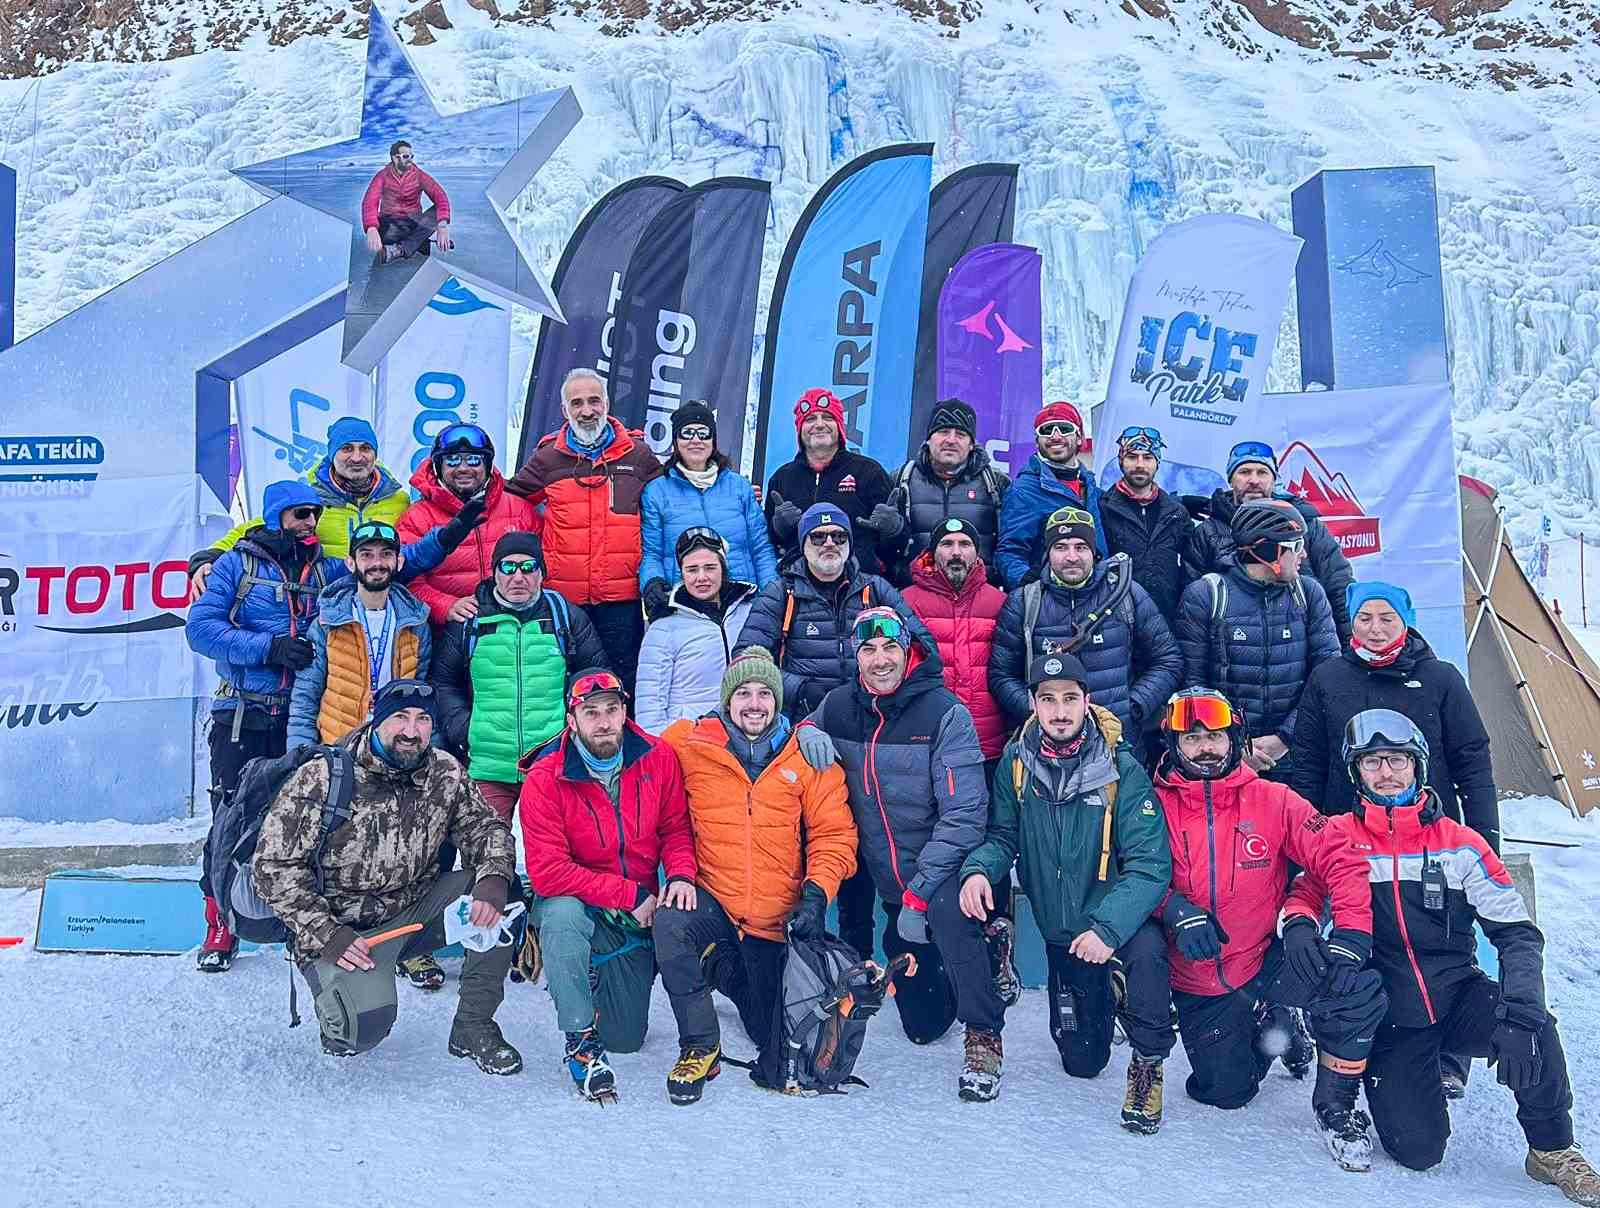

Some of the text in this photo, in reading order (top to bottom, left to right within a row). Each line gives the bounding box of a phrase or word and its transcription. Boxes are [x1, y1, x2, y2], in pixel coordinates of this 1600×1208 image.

[1131, 311, 1259, 402] ICE
[1145, 371, 1225, 407] Park
[35, 438, 97, 459] TEKİN
